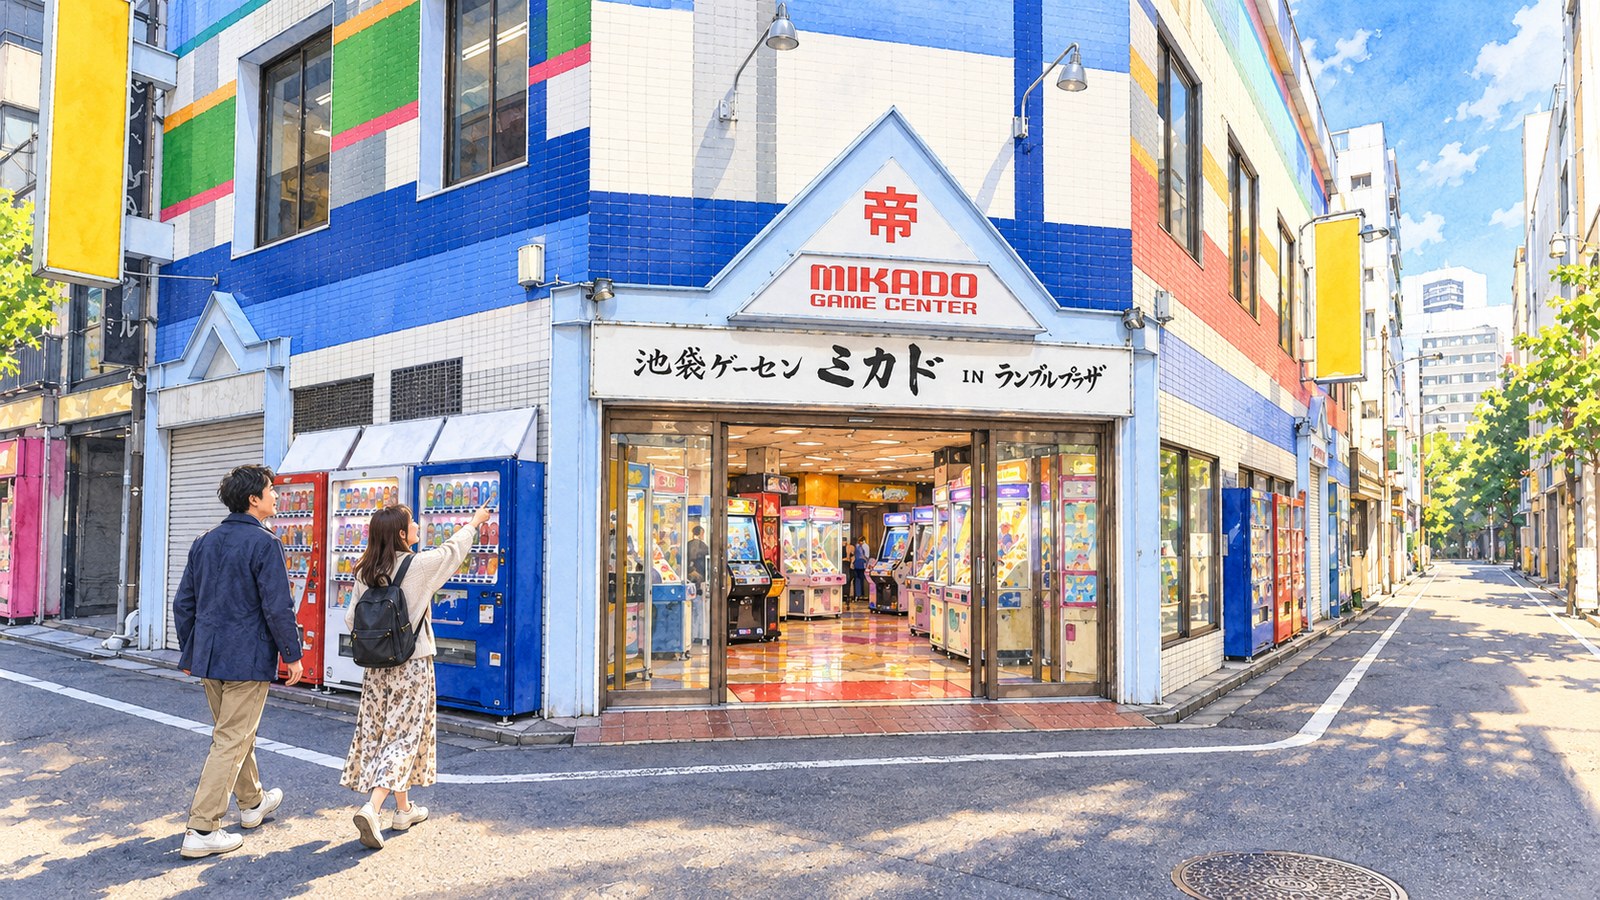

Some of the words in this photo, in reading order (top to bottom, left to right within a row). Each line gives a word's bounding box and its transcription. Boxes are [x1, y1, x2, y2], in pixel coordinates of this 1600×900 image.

[864, 186, 918, 244] 帝
[810, 264, 978, 299] MIKADO
[810, 293, 877, 310] GAME
[884, 297, 977, 315] CENTER
[633, 346, 803, 381] 池袋ゲーセン
[817, 343, 944, 397] ミカド
[962, 369, 984, 384] IN
[995, 363, 1107, 394] ランブルプラザ
